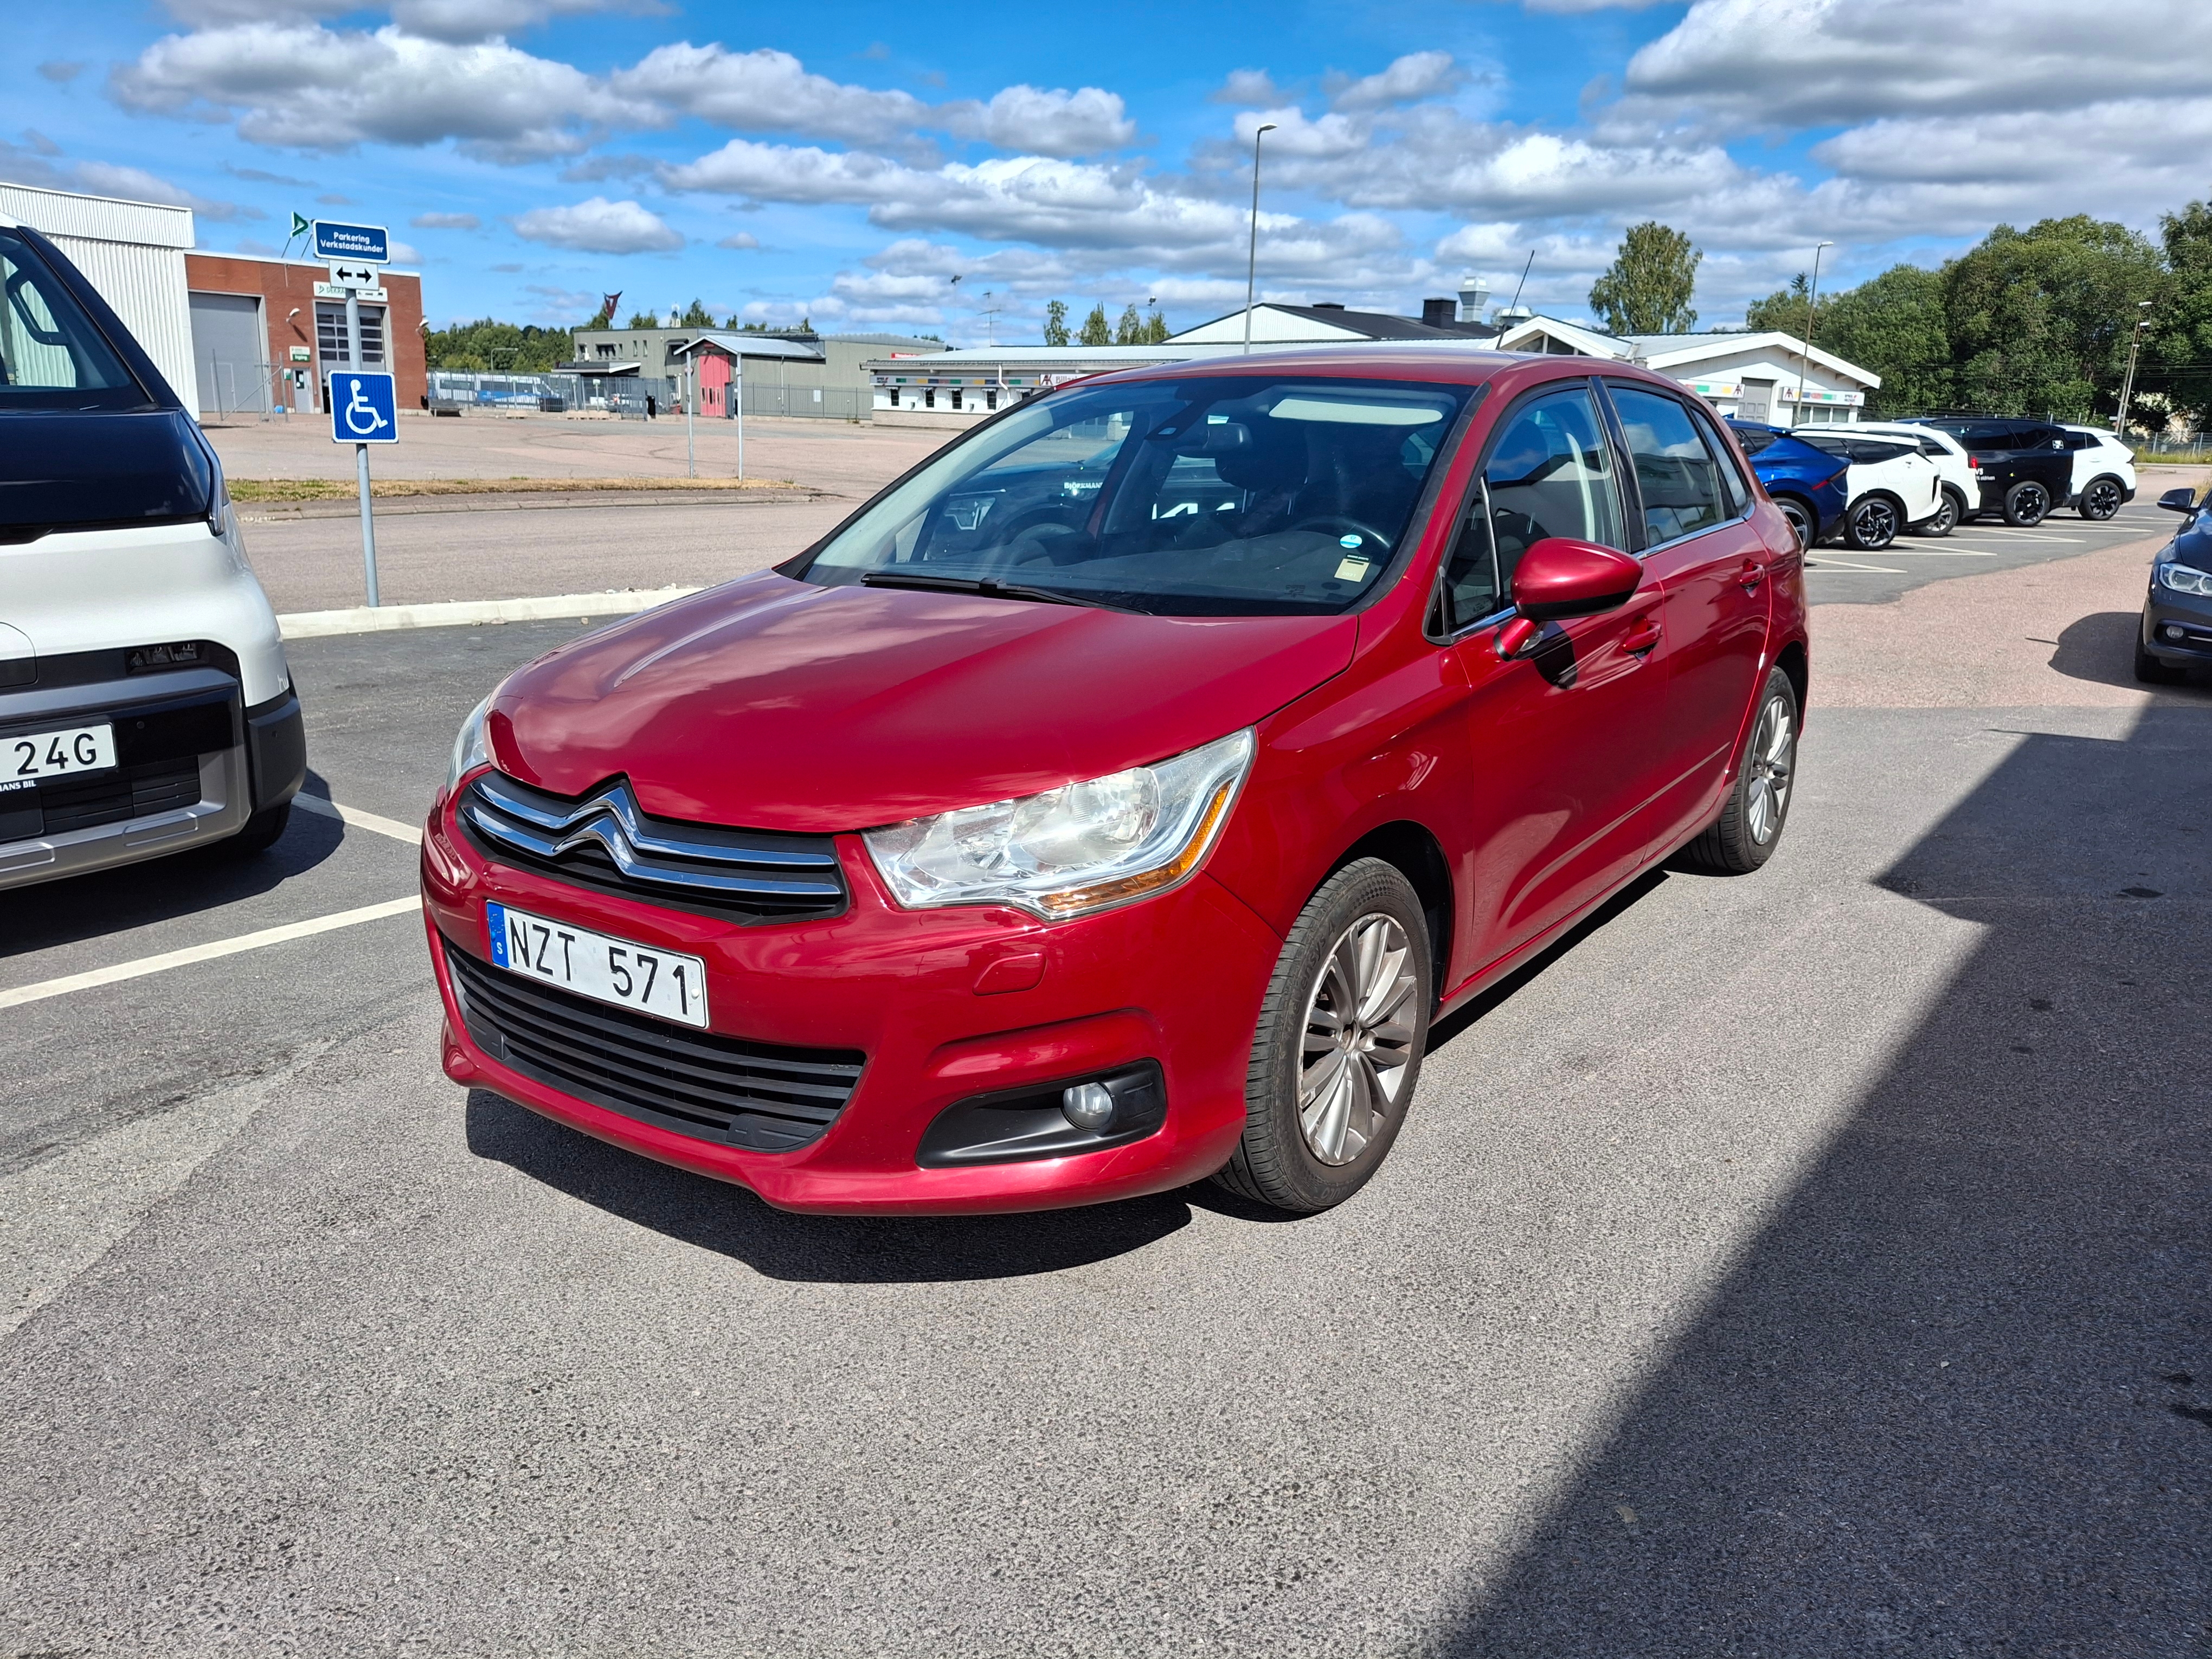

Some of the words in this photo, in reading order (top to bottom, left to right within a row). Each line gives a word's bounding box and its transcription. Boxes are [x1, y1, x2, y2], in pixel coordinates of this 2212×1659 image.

[333, 232, 370, 245] Parkering
[320, 239, 384, 253] Verkstadskunder
[14, 733, 97, 776] 24G
[23, 780, 36, 789] BIL
[496, 942, 503, 955] S
[510, 917, 575, 982] NZT
[608, 946, 689, 1015] 571
